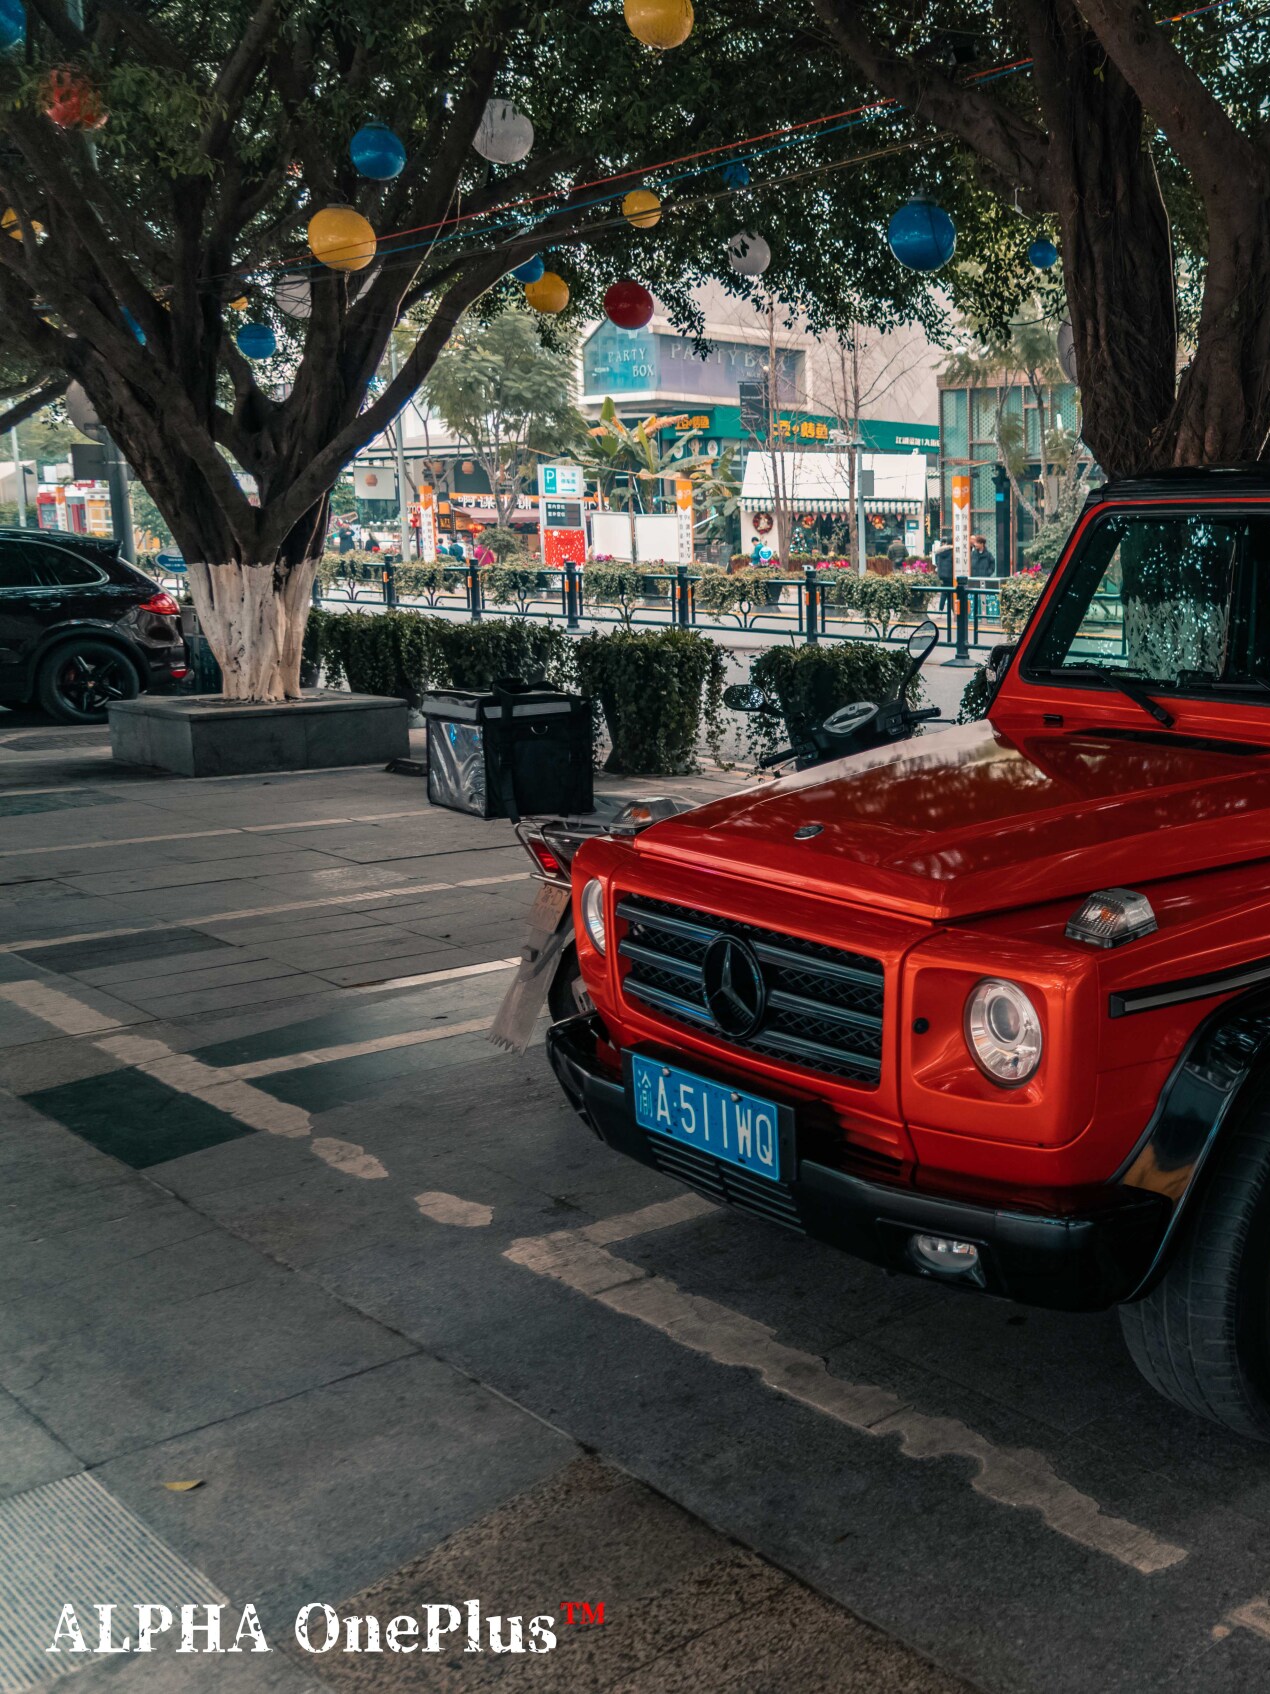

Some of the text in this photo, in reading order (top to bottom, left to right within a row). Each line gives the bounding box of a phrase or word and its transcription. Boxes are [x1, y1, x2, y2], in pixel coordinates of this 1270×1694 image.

[608, 347, 646, 363] PARTY
[632, 364, 654, 377] BOX
[546, 470, 555, 484] P
